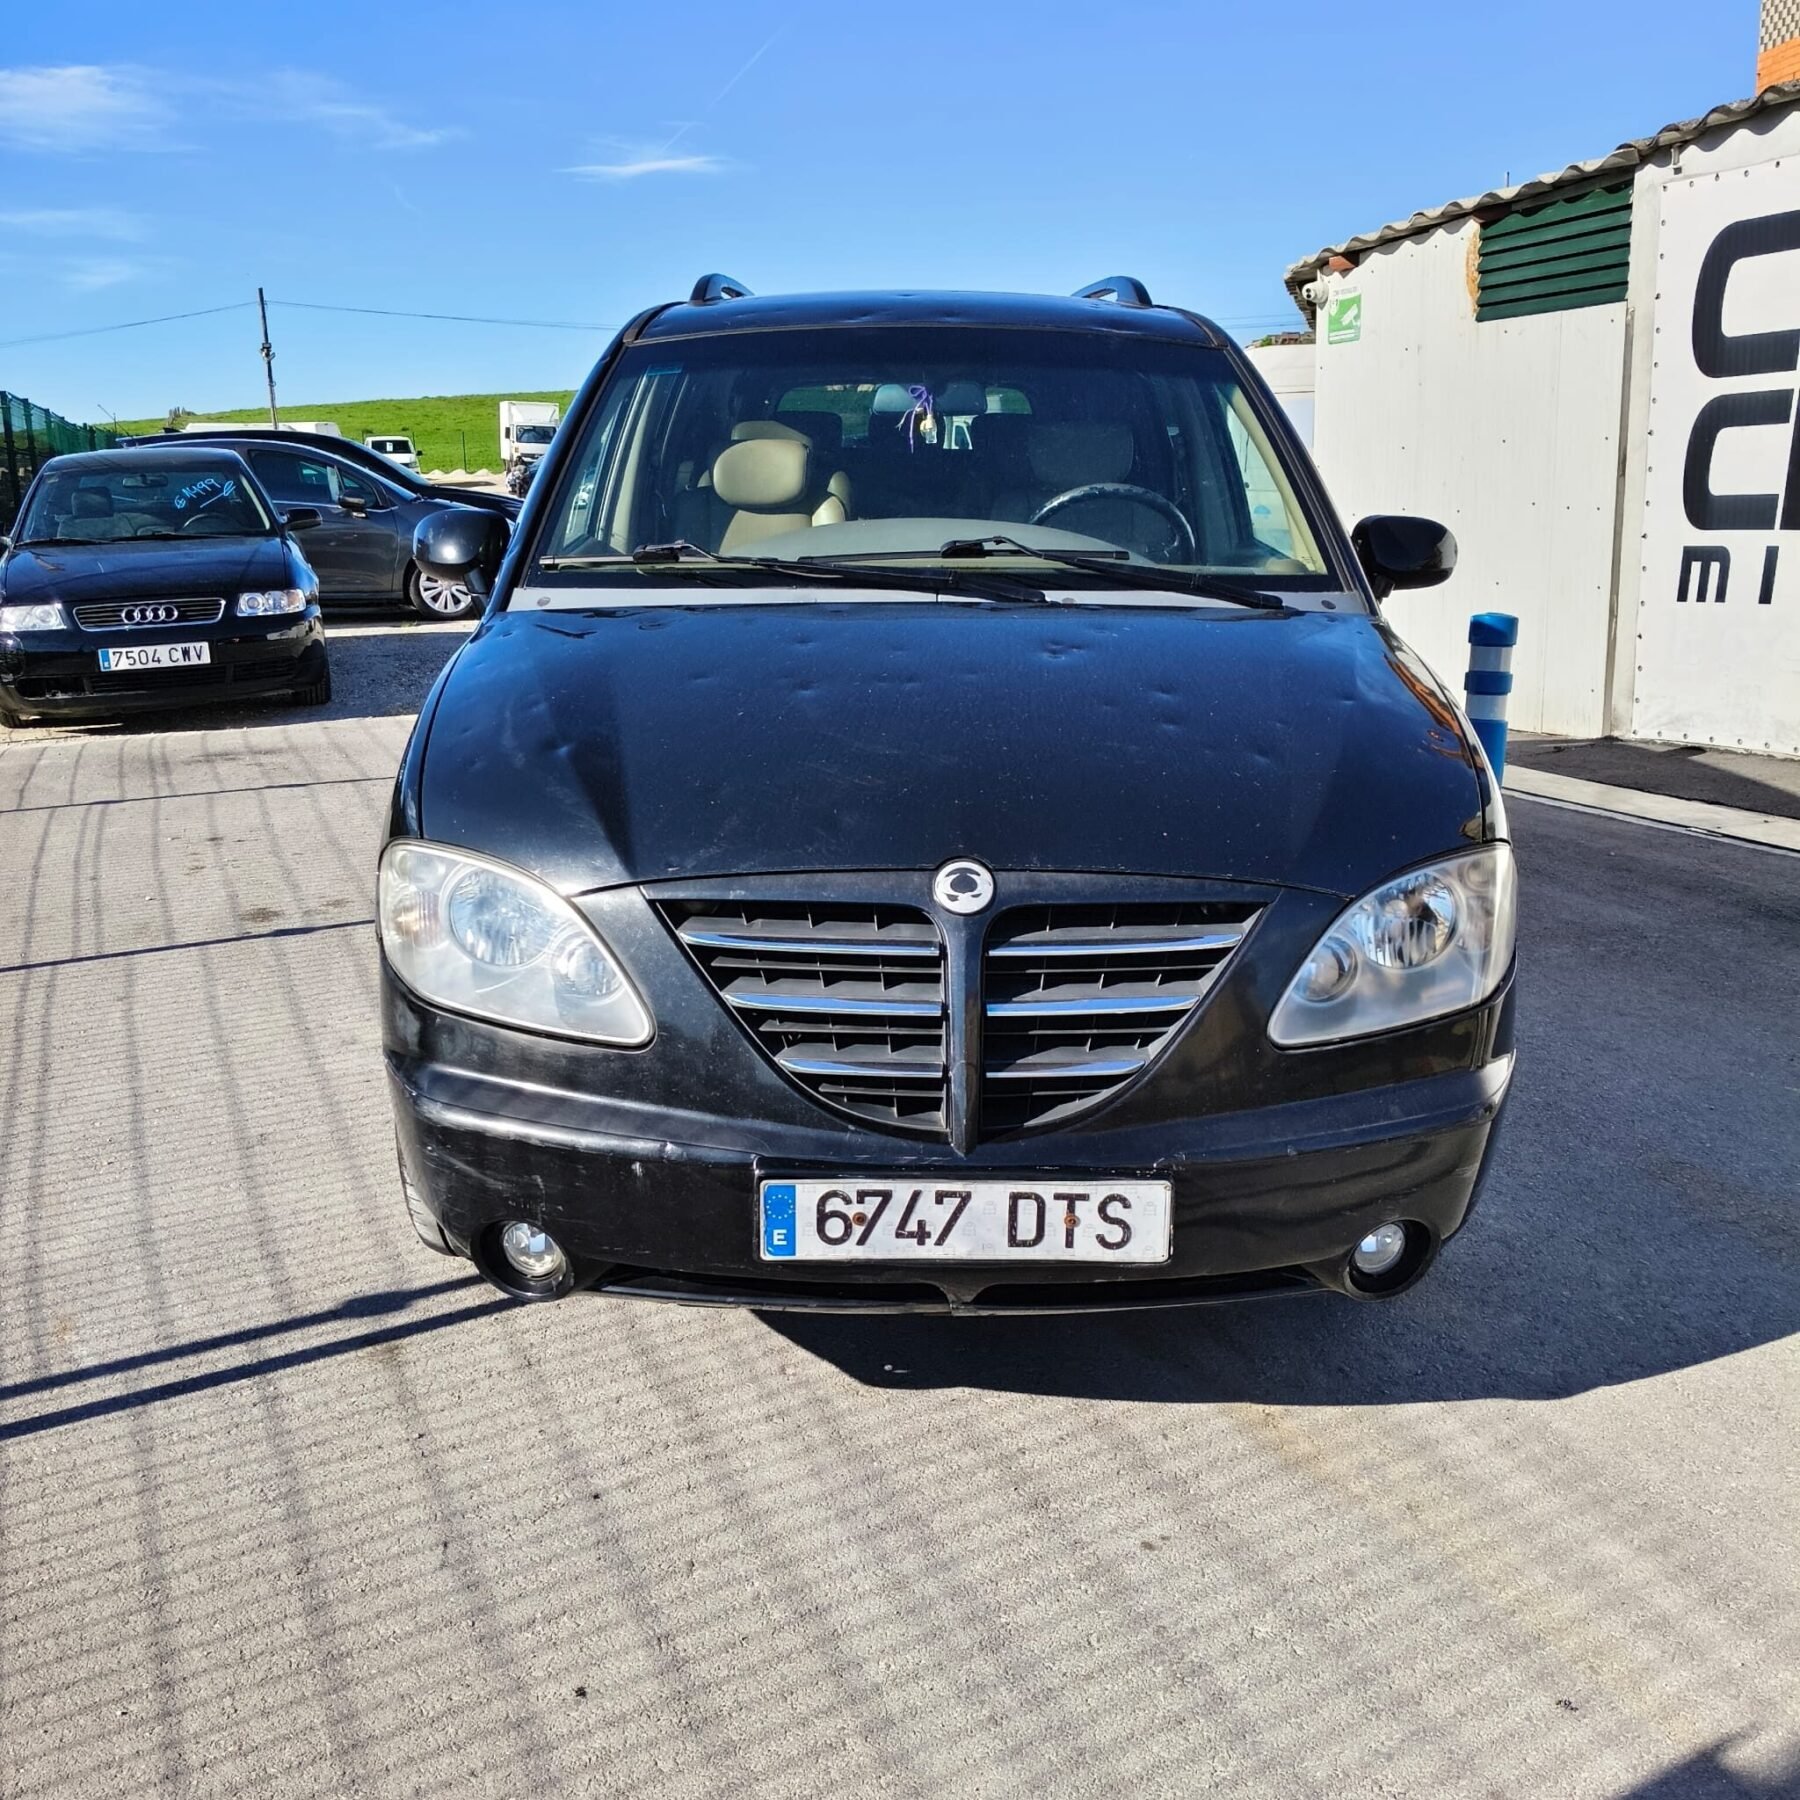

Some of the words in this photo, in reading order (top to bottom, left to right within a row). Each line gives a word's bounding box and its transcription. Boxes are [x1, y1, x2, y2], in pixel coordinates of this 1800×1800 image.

[112, 648, 162, 668] 7504
[168, 645, 203, 663] CWV
[773, 1229, 787, 1245] E
[815, 1189, 972, 1246] 6747
[1007, 1191, 1132, 1250] DTS
